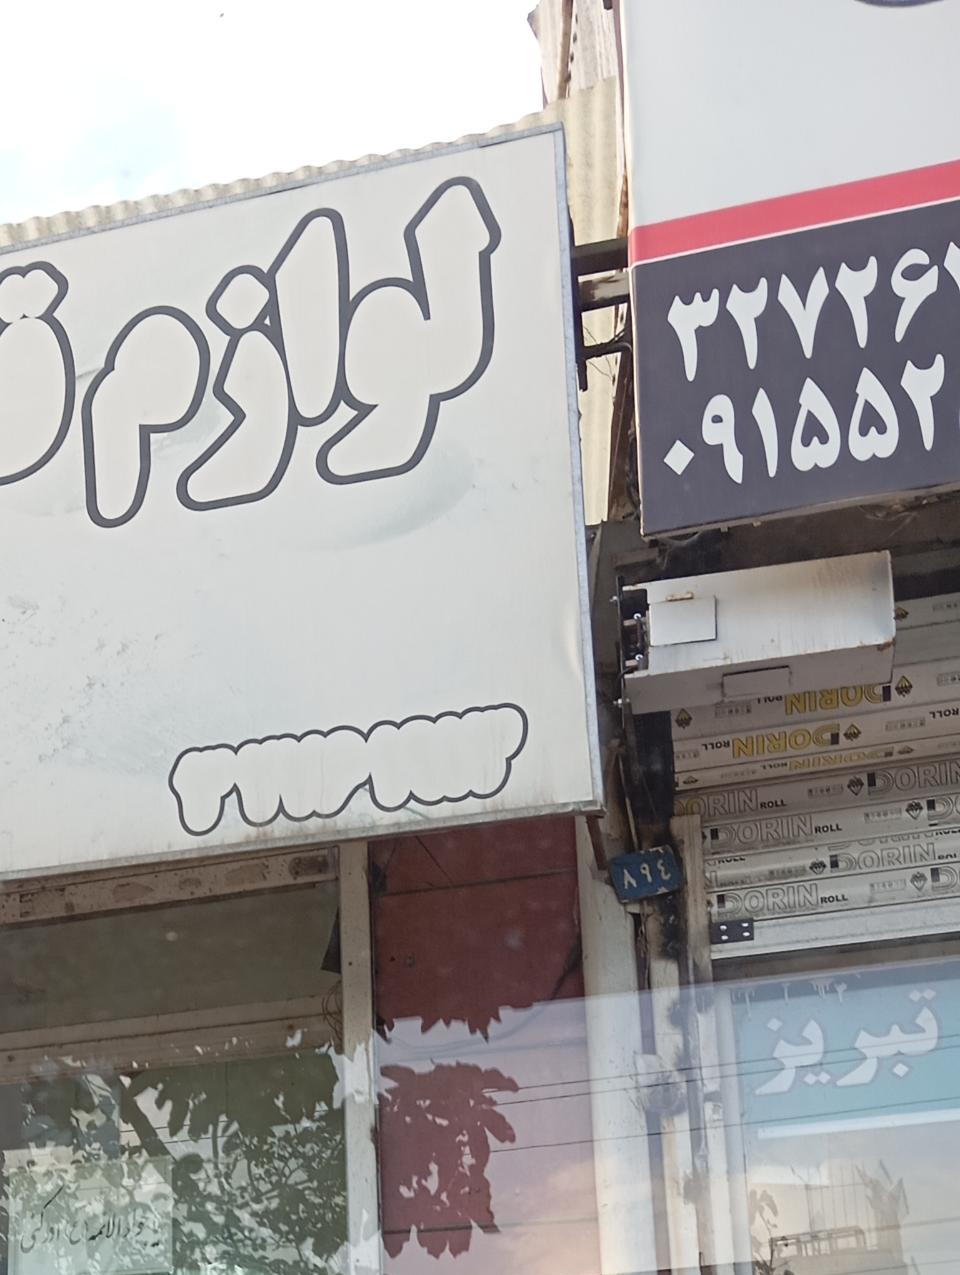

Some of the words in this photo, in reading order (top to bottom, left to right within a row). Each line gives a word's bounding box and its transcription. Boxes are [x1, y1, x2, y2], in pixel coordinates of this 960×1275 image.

[83, 176, 502, 528] لوازم
[664, 354, 960, 484] ۰۹۱۵۵۲
[701, 740, 730, 751] ROLL
[731, 724, 840, 759] DORIN
[760, 799, 787, 809] ROLL
[710, 814, 813, 852] DORIN
[814, 823, 843, 834] ROLL
[829, 842, 936, 874] DORIN
[717, 882, 819, 916] DORIN
[820, 893, 849, 904] ROLL
[755, 988, 939, 1095] تبریز
